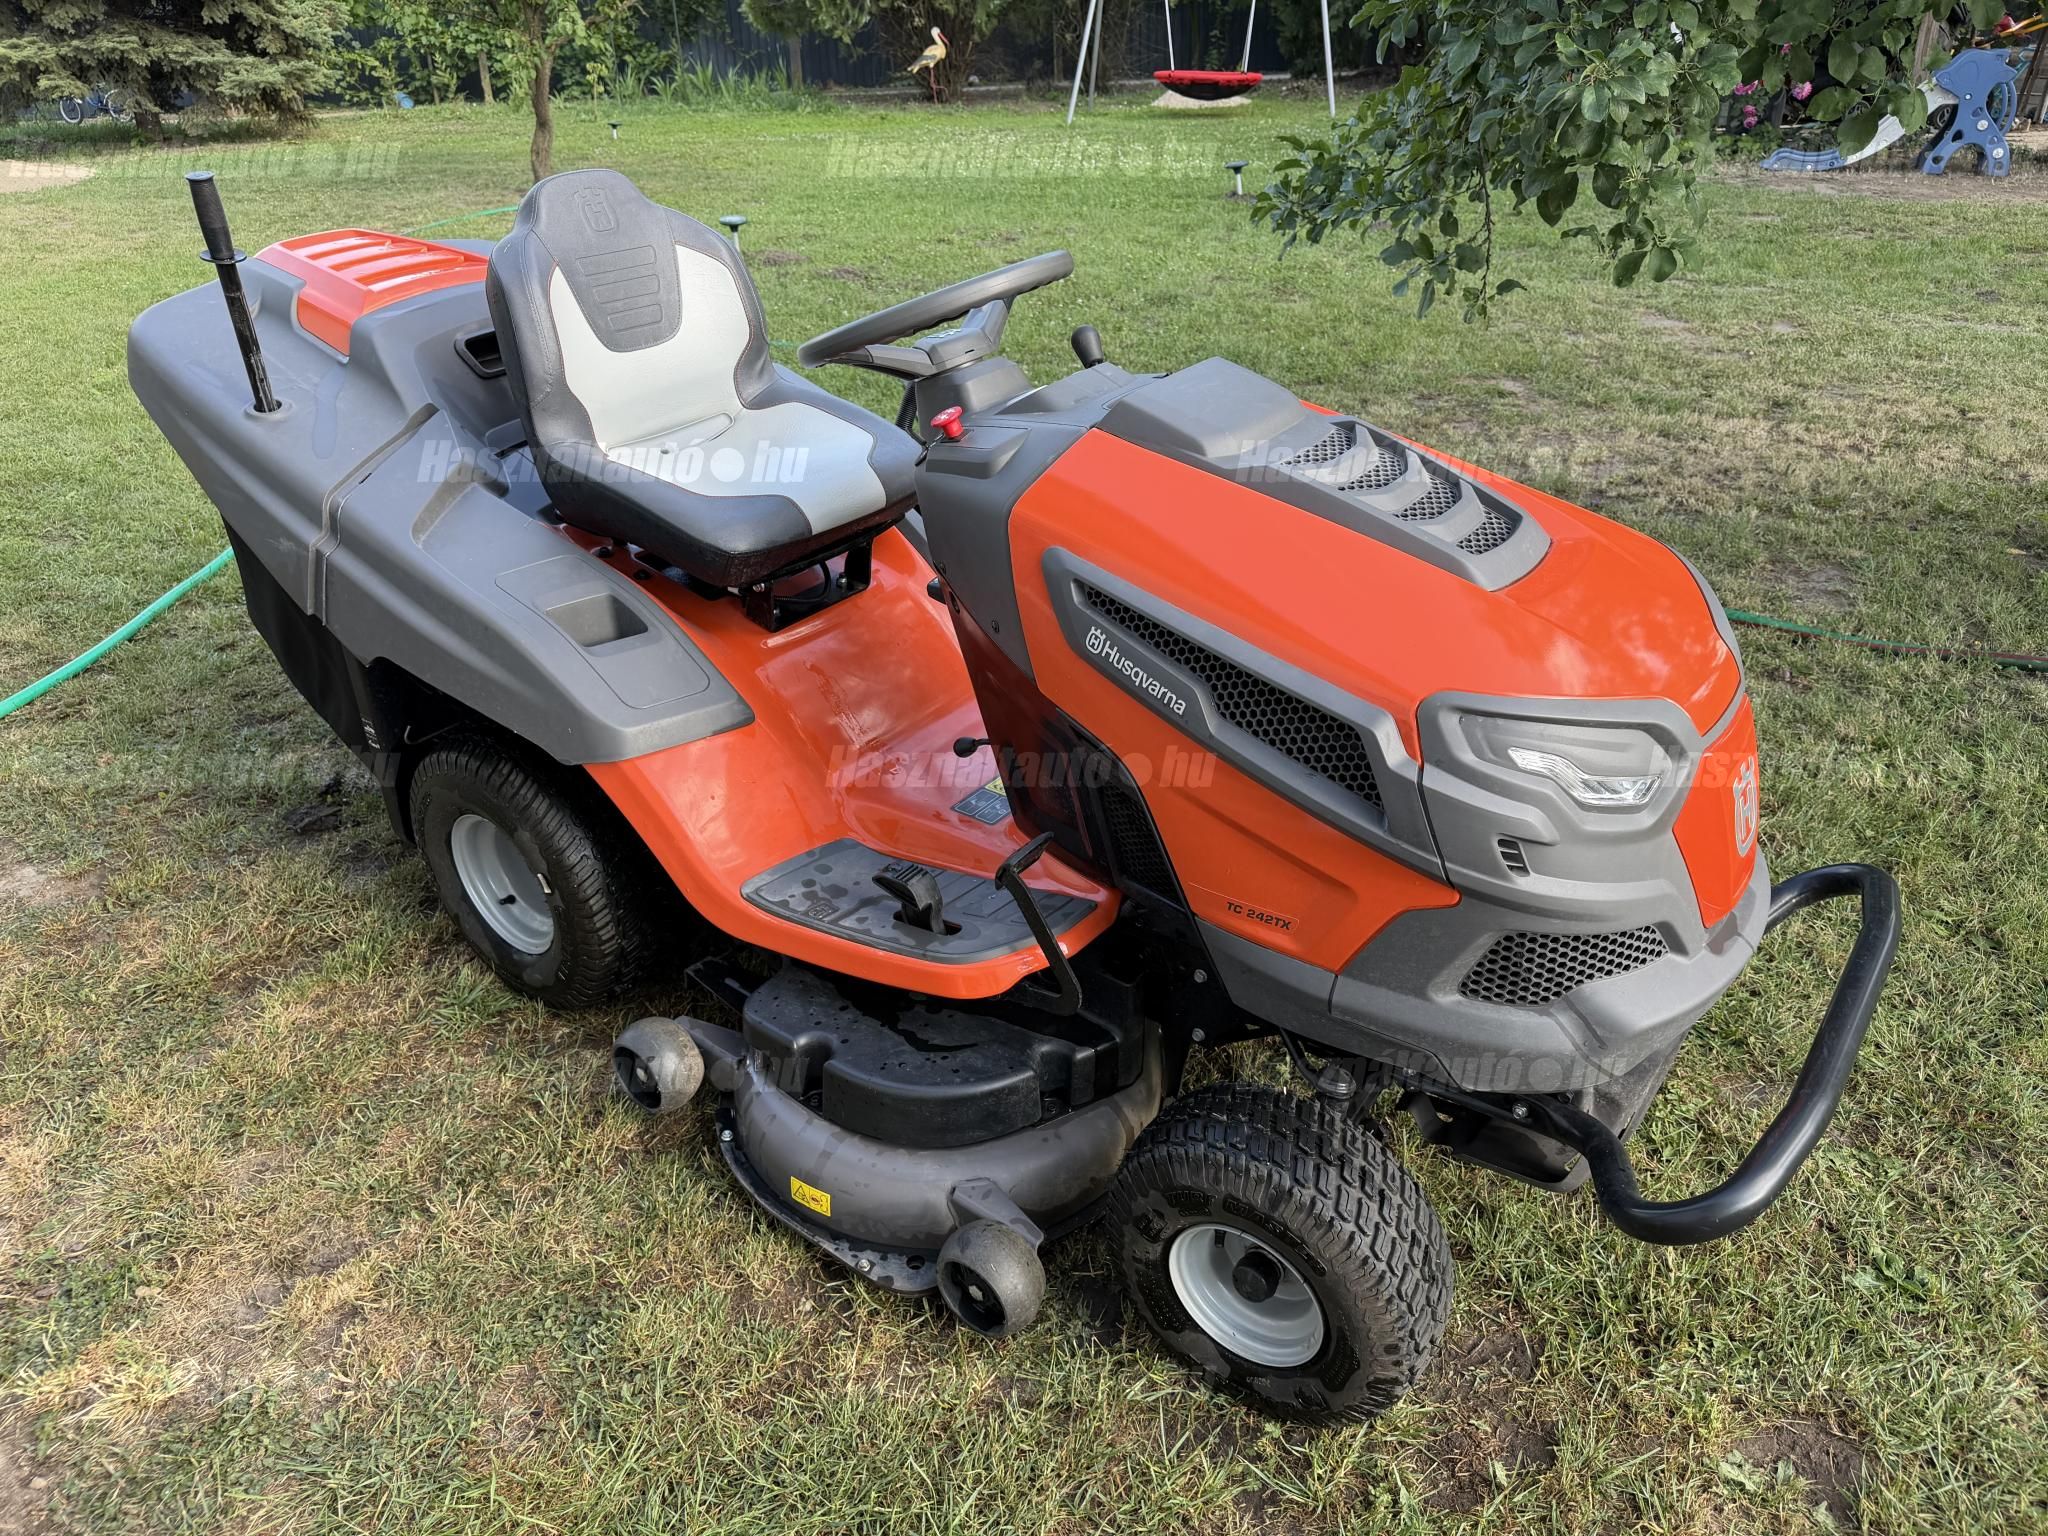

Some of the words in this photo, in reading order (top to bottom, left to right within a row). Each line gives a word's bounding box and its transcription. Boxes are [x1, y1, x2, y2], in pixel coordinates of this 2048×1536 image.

[1101, 640, 1187, 716] Husqvarna
[1226, 901, 1243, 915] TC
[1246, 908, 1292, 931] 242TX
